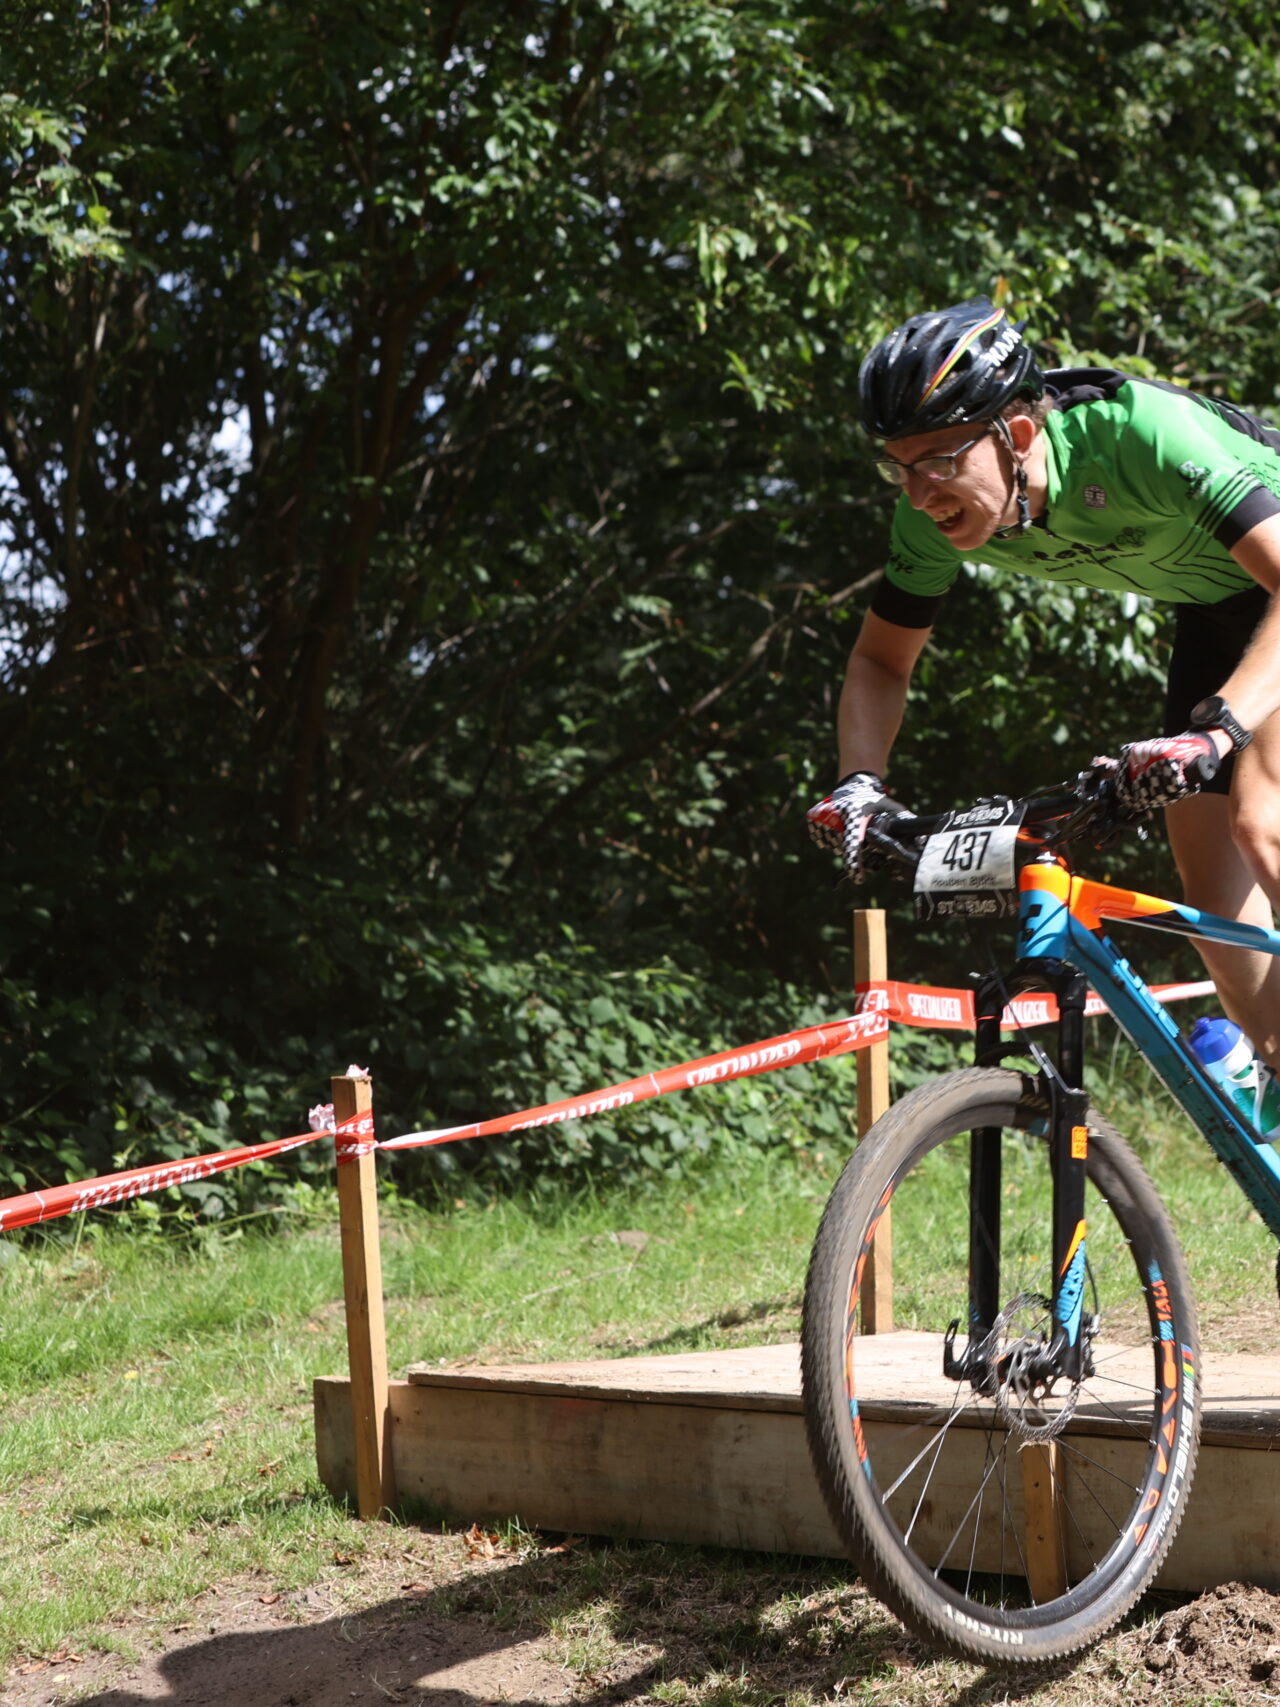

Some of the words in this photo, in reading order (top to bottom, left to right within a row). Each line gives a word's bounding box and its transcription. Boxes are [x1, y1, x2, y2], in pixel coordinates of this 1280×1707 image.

[942, 830, 993, 871] 437
[1167, 1405, 1194, 1508] SHIELD
[942, 1603, 1024, 1645] RITCHEY
